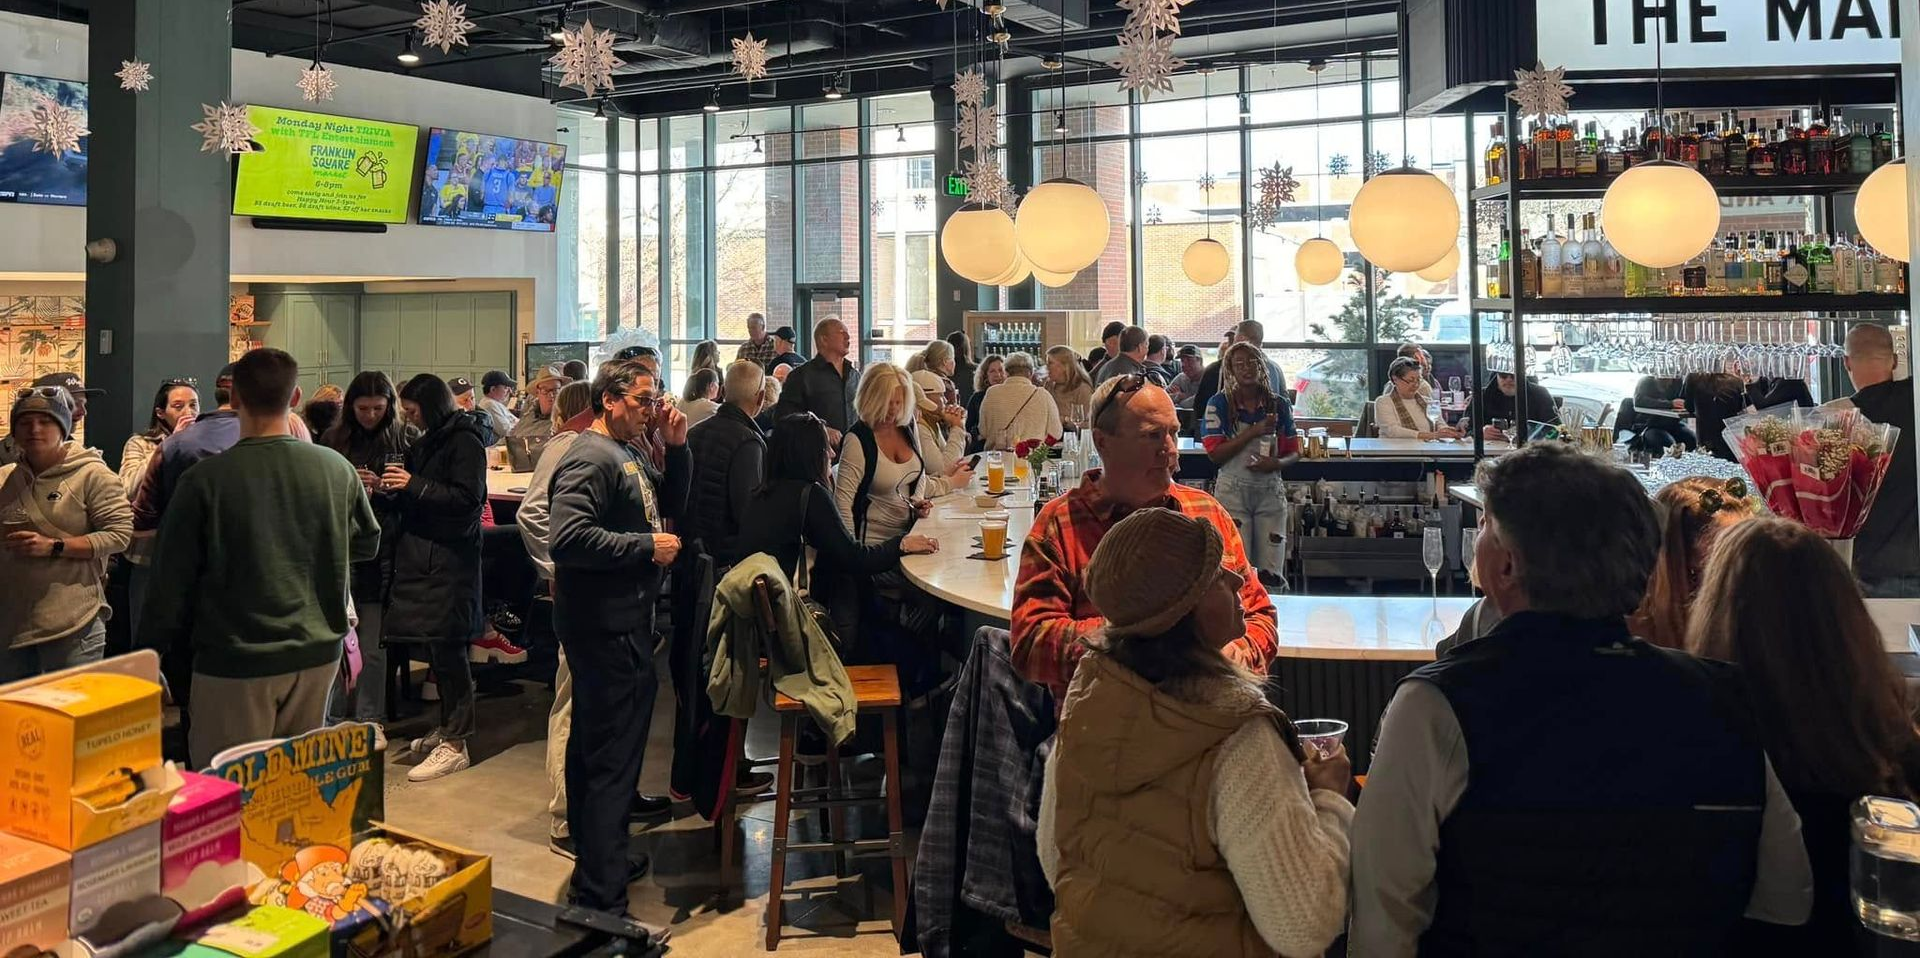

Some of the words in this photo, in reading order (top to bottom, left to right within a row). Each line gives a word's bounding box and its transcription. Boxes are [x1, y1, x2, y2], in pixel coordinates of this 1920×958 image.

[1594, 0, 1726, 45] THE
[271, 126, 296, 138] with
[299, 128, 320, 140] TFL
[321, 132, 395, 147] Entertainment
[276, 116, 322, 131] Monday
[324, 121, 354, 135] Night
[356, 125, 391, 138] TRIVIA
[310, 145, 356, 160] FRANKLIN
[312, 157, 351, 170] SQUARE
[493, 179, 502, 194] 3
[297, 196, 318, 204] Happy
[20, 729, 41, 750] REAL
[86, 731, 121, 750] TUPELO
[122, 722, 152, 740] HONEY
[292, 724, 370, 771] MINE
[336, 759, 371, 780] GUM
[77, 866, 120, 890] ROSEMARY
[31, 897, 49, 912] TEA
